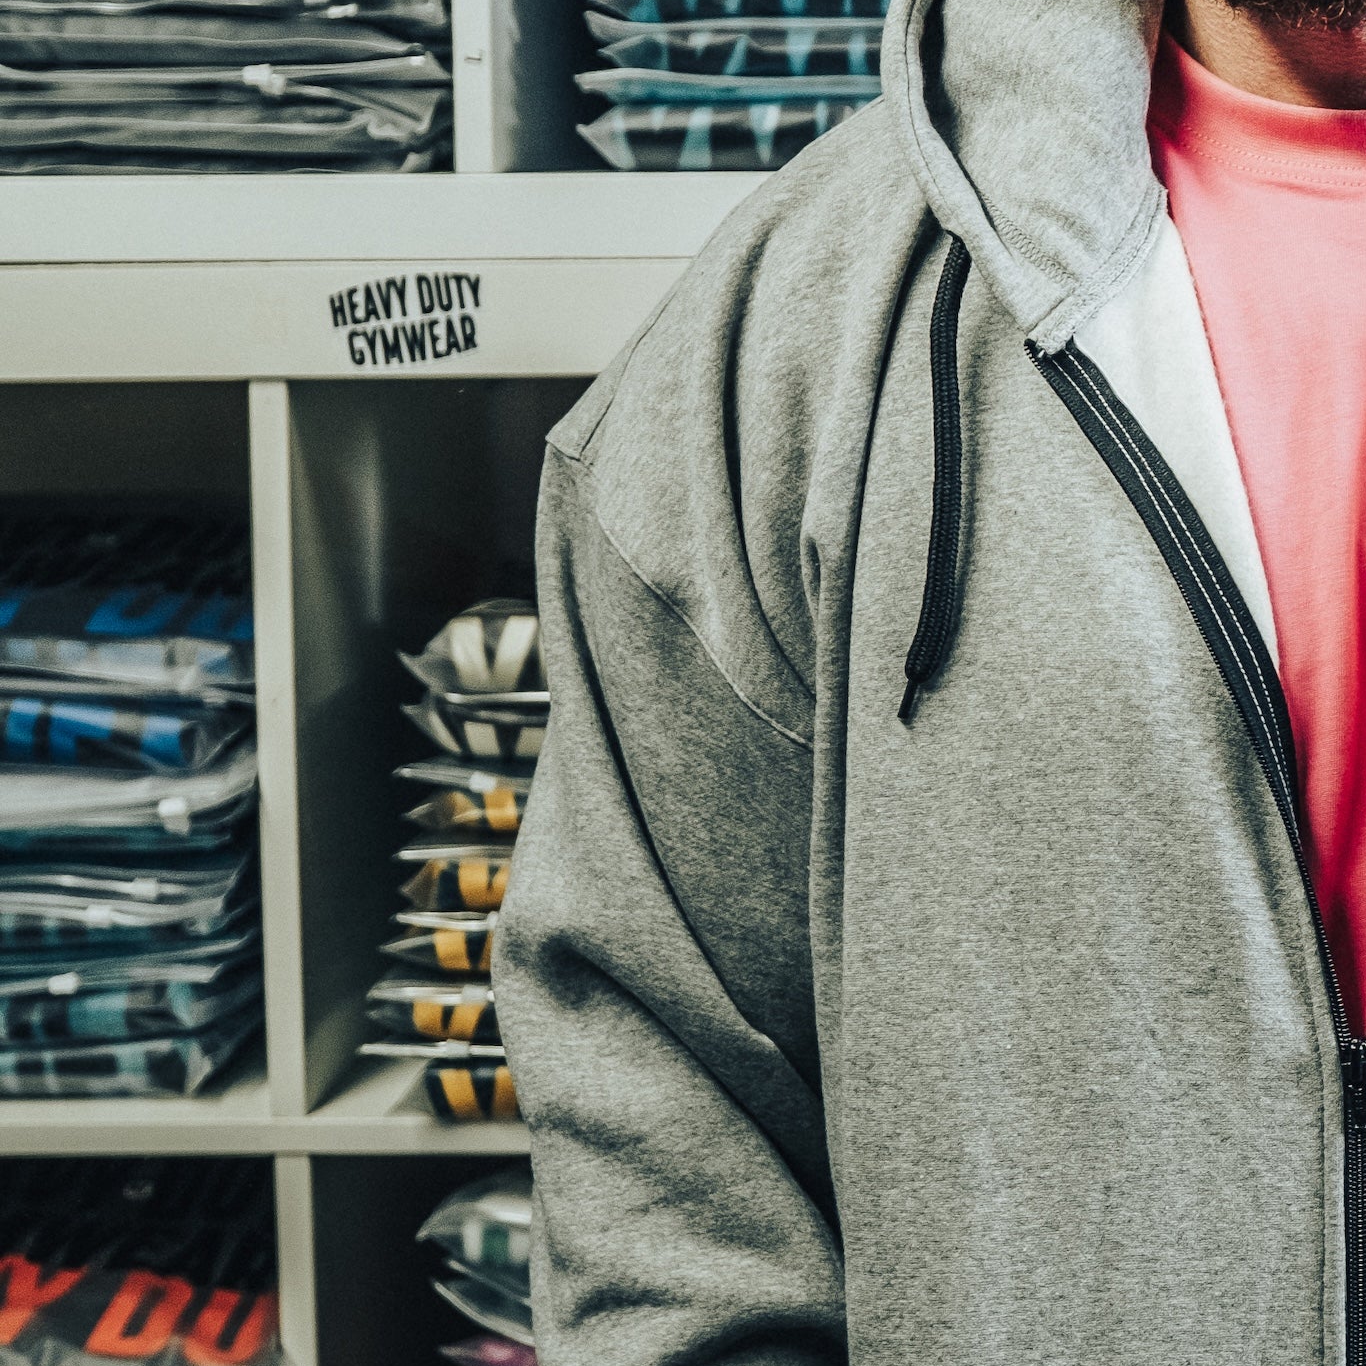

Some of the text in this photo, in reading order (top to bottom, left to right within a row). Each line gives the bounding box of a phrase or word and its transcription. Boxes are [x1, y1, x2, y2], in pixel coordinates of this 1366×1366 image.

[329, 271, 481, 327] HEAVY DUTY
[348, 313, 477, 365] GYMWEAR
